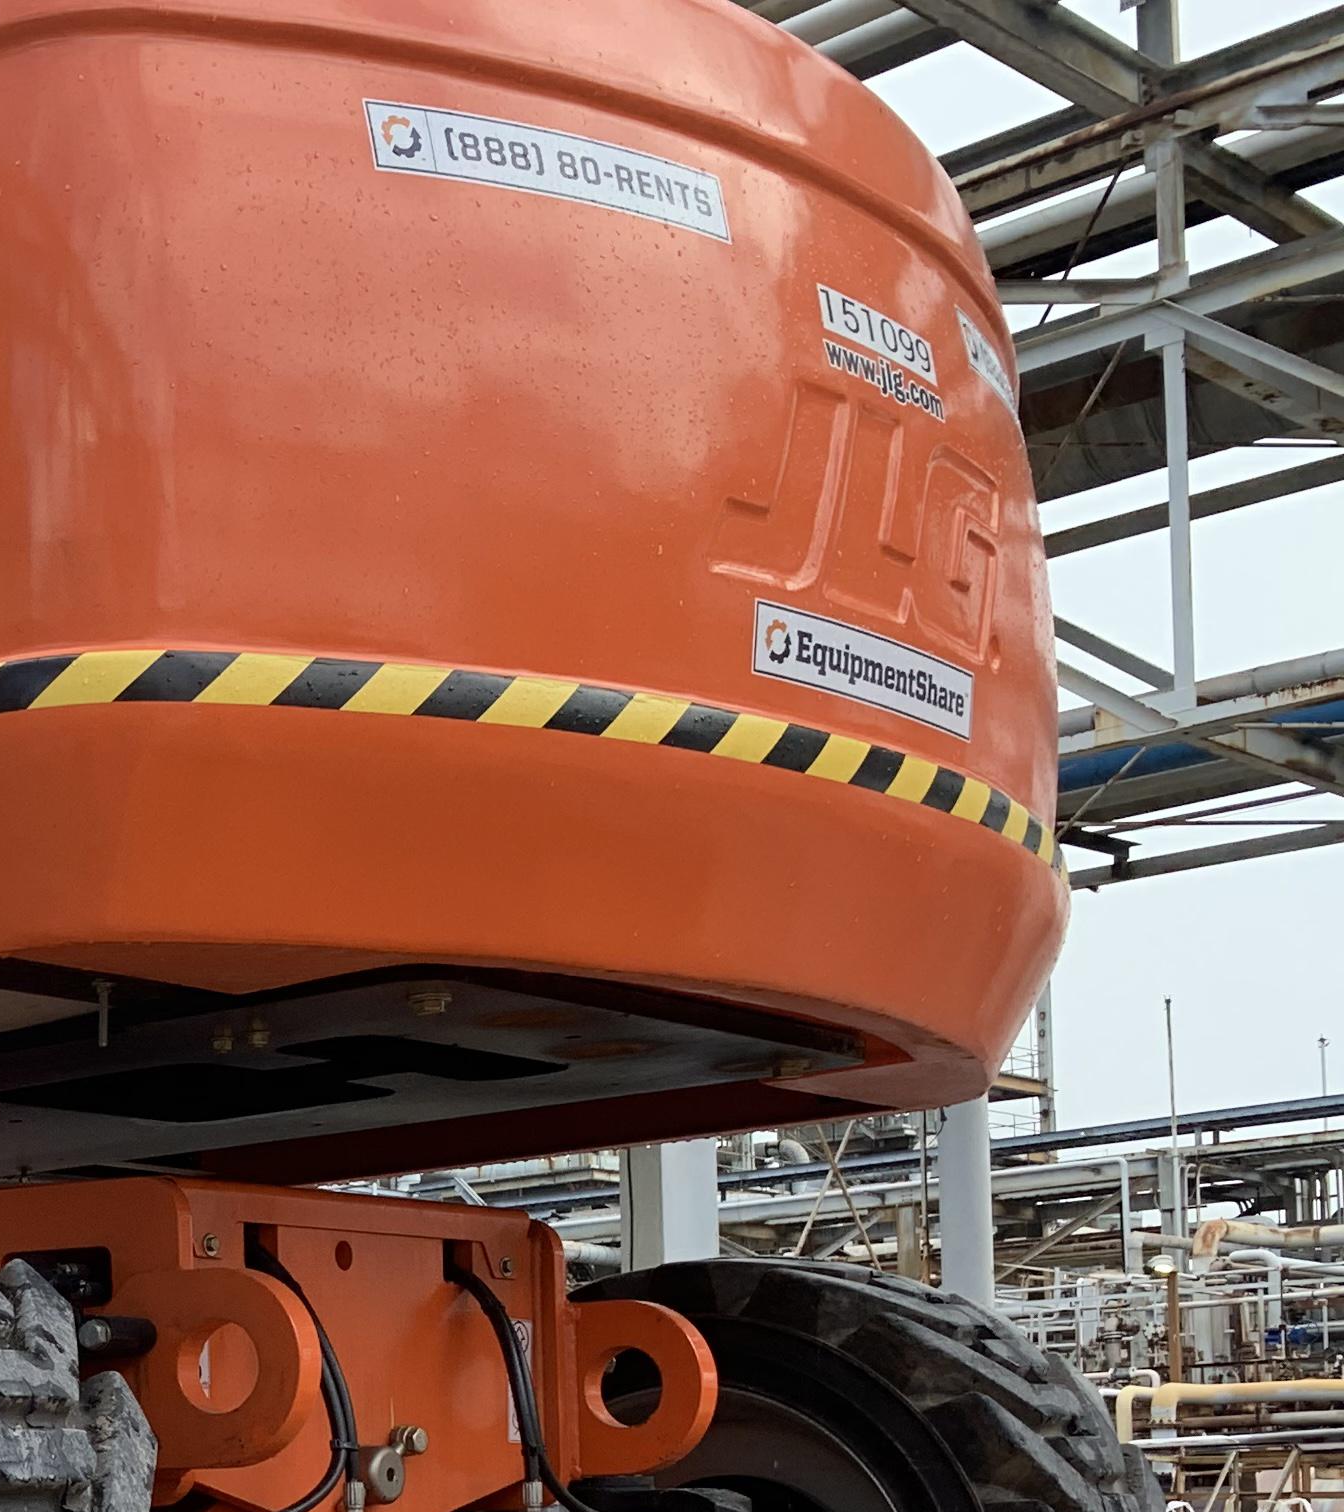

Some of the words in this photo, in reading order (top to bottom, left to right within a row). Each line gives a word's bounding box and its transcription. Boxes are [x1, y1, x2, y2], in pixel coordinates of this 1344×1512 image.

[445, 127, 545, 176] (888)
[557, 149, 713, 217] 80-RENTS
[819, 287, 931, 373] 151099
[824, 340, 945, 421] www.jlg.com
[709, 379, 999, 668] JLG
[795, 629, 964, 717] EquipmentShare
